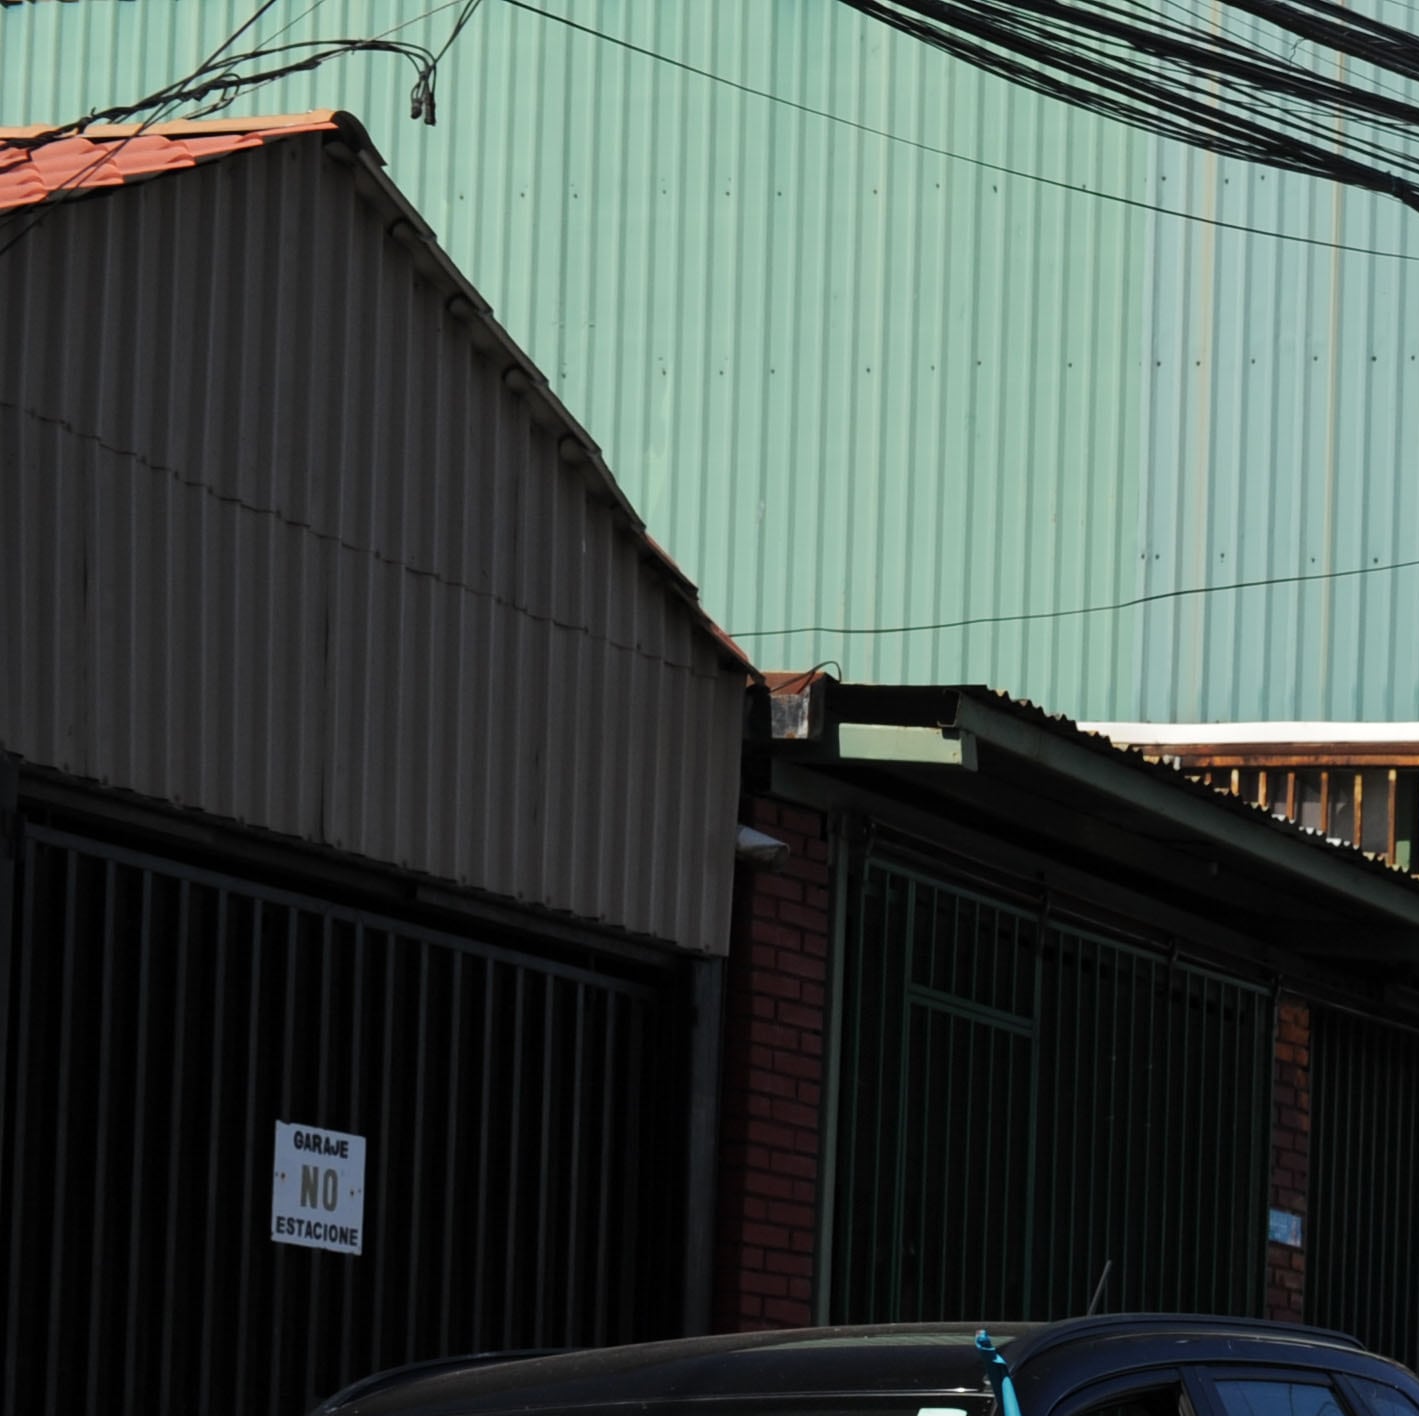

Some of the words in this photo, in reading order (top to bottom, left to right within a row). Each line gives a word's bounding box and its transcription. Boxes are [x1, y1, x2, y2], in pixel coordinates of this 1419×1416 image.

[293, 1131, 349, 1159] GARAJE
[300, 1164, 338, 1212] NO
[276, 1215, 359, 1247] ESTACIONE
